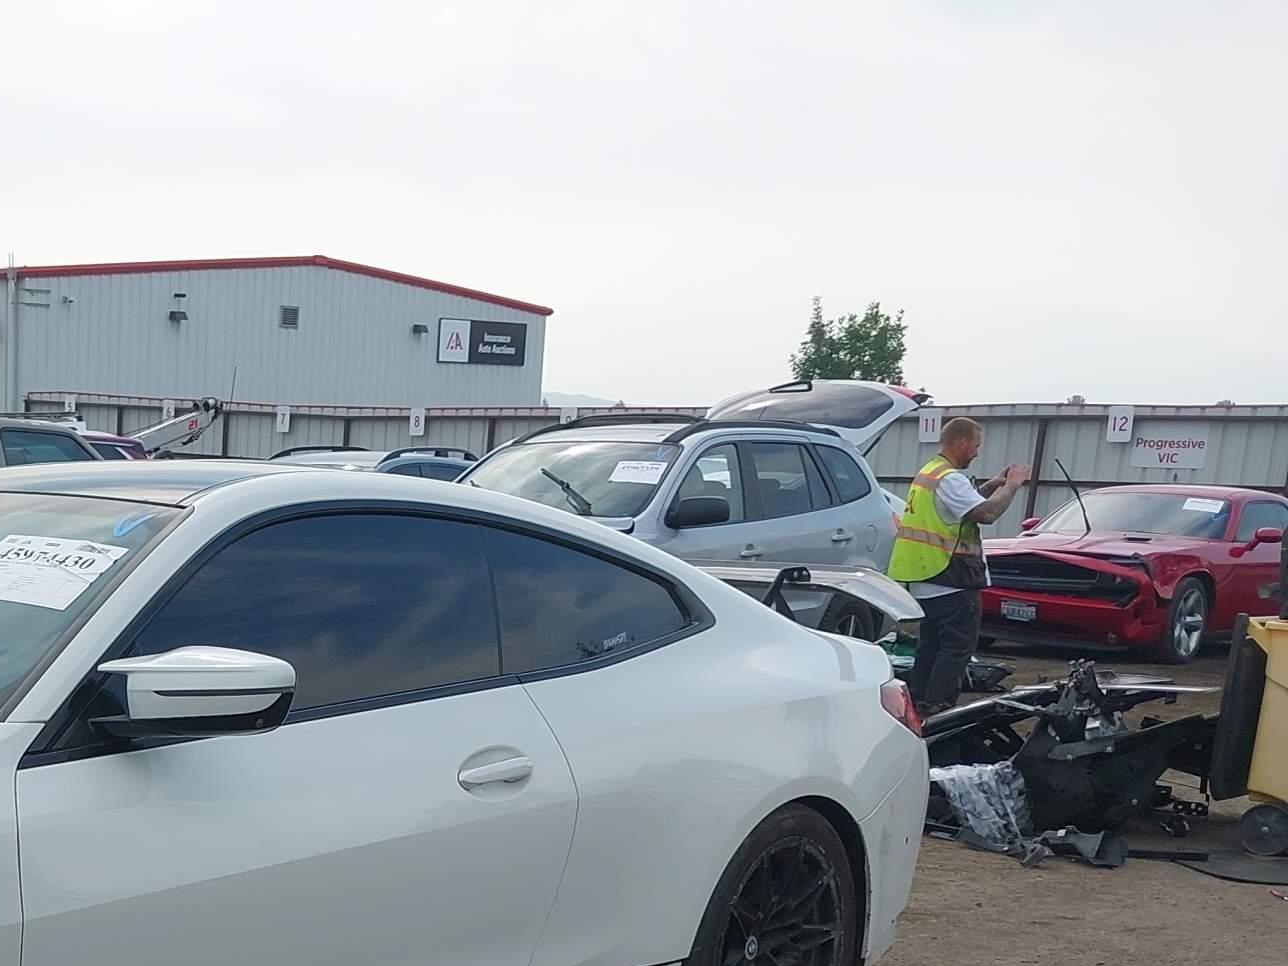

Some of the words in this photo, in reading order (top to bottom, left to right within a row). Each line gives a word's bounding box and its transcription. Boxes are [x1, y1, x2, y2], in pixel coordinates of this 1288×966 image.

[478, 343, 491, 354] Auto
[280, 413, 287, 425] 7
[414, 415, 420, 428] 8
[924, 417, 936, 433] 11
[1112, 416, 1129, 432] 12
[1134, 436, 1206, 450] Progressive
[1158, 452, 1179, 464] VIC
